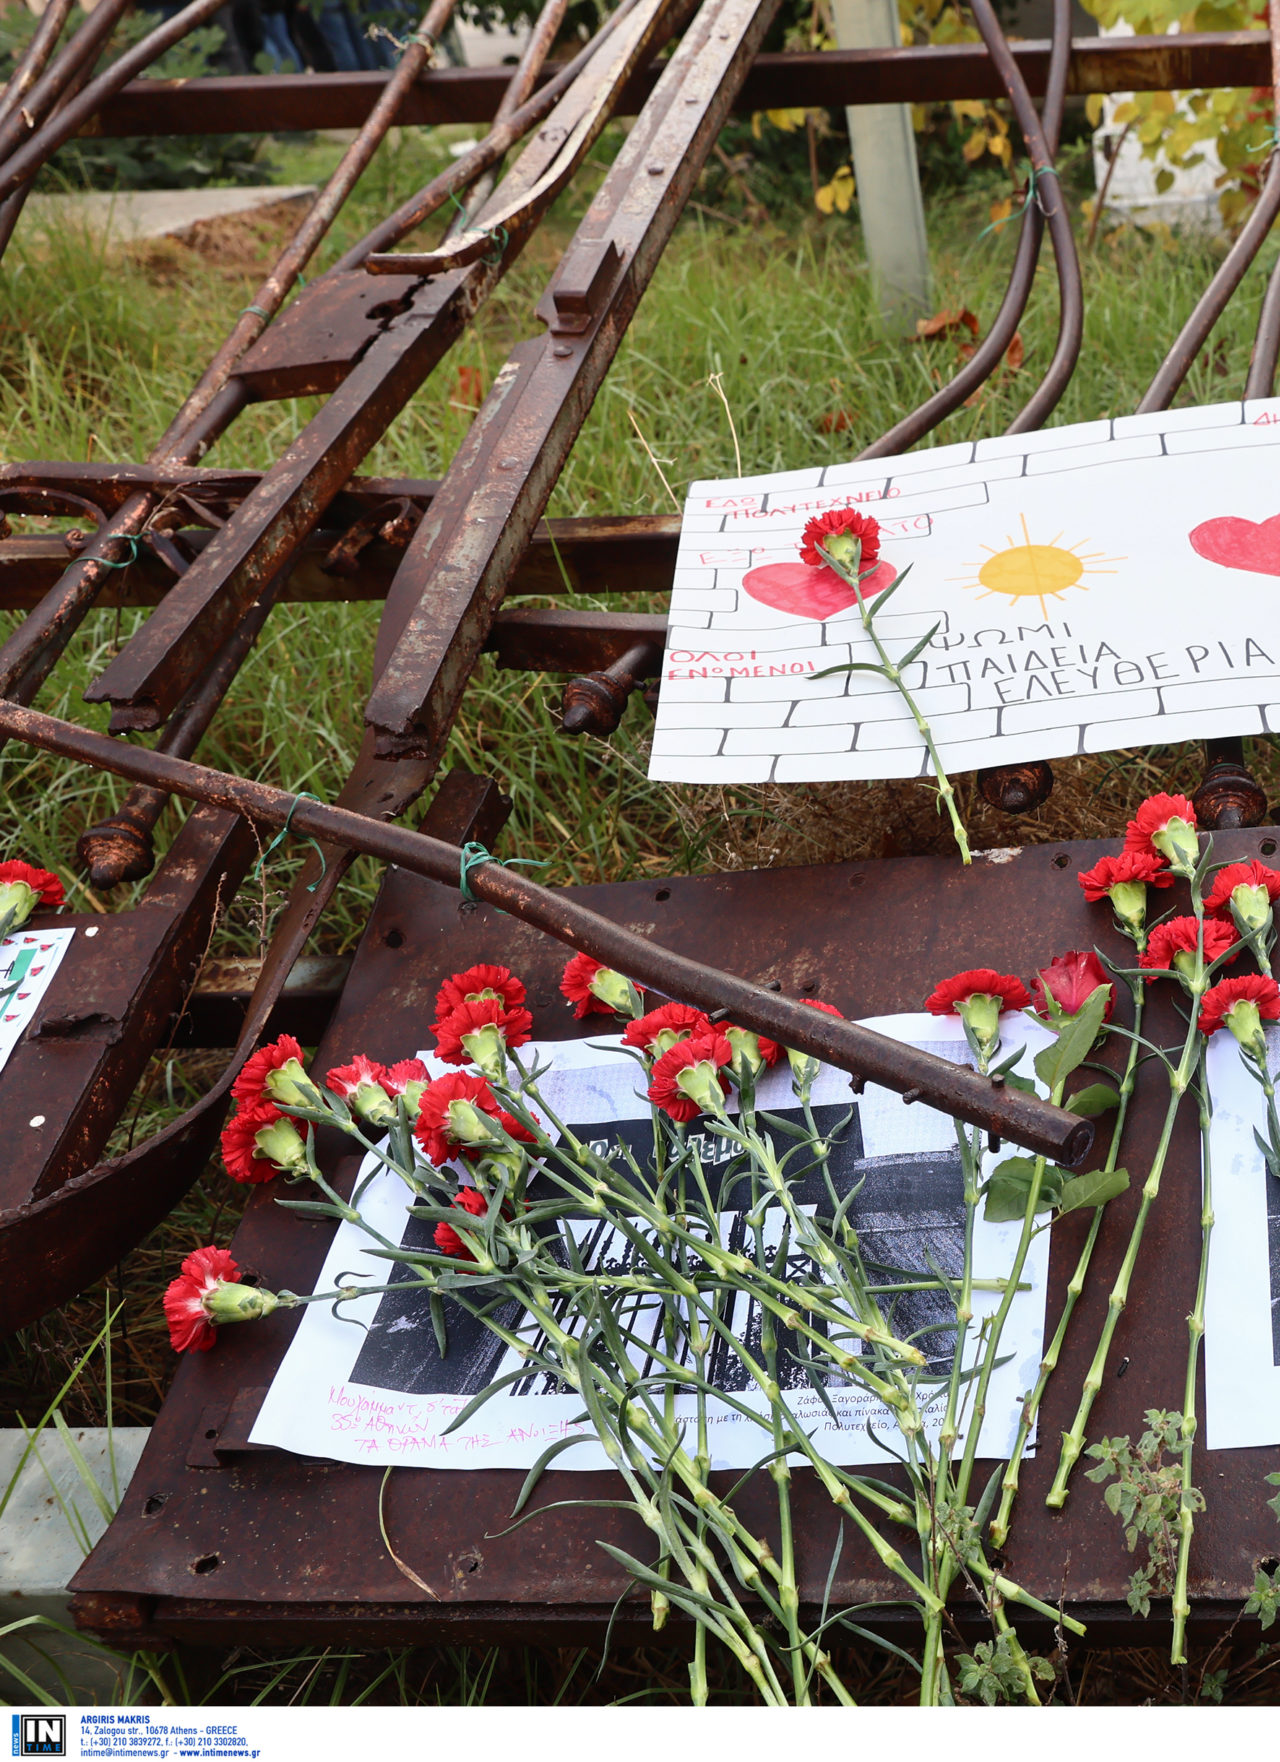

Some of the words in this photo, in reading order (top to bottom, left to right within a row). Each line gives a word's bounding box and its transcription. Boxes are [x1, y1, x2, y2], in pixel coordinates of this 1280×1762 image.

[929, 621, 1072, 650] ΨΩΜΙ
[669, 650, 757, 663] ΟΛΟΙ
[936, 641, 1121, 684] ΠΑΙΔΕΙΑ
[994, 637, 1275, 705] ΕΛΕΥΘΕΡΙΑ
